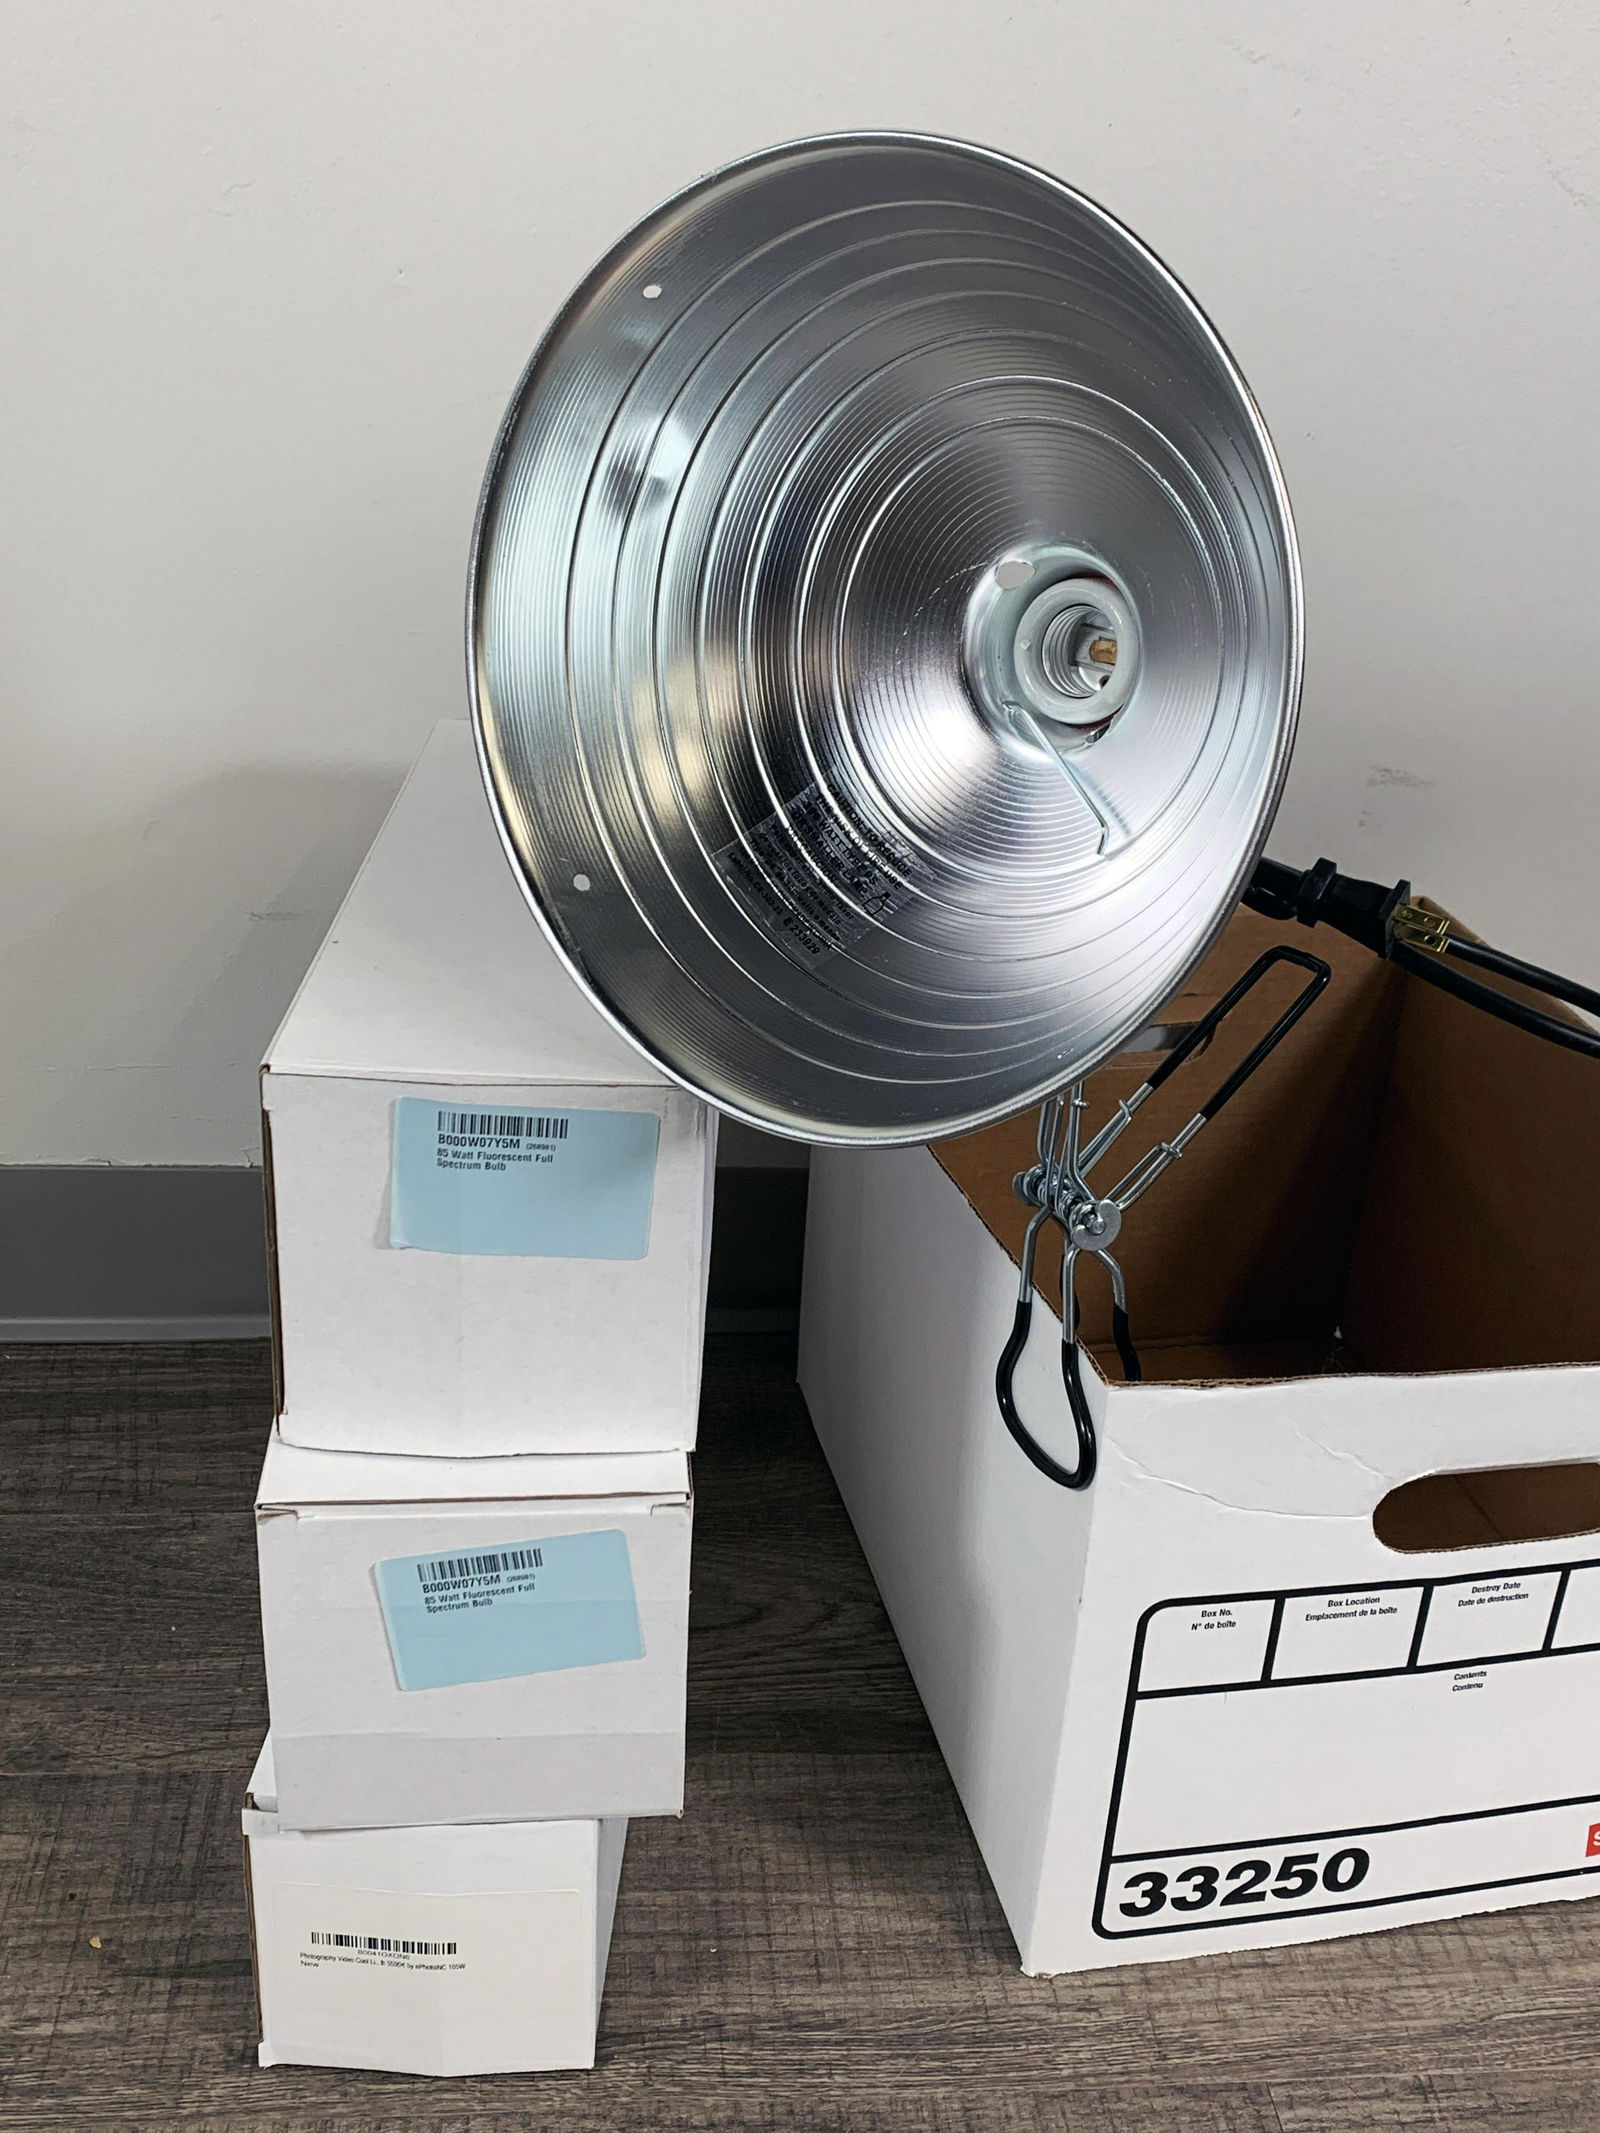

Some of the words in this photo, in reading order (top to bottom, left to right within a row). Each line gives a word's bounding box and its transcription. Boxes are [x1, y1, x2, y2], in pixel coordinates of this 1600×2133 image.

[438, 1134, 520, 1148] B000W07Y5M
[437, 1148, 448, 1157] 85
[451, 1150, 473, 1159] Watt
[477, 1151, 532, 1162] Fluorescent
[536, 1154, 553, 1163] Full
[437, 1158, 481, 1169] Spectrum
[485, 1162, 506, 1171] Bulb
[423, 1575, 501, 1594] B000W07Y5M
[1471, 1584, 1501, 1594] Destroy
[1503, 1582, 1522, 1590] Date
[424, 1596, 436, 1605] 85
[438, 1594, 460, 1602] Watt
[463, 1586, 515, 1600] Fluorescent
[518, 1583, 535, 1592] Full
[1458, 1599, 1475, 1608] Date
[1487, 1592, 1529, 1603] destruction
[426, 1602, 469, 1614] Spectrum
[472, 1599, 493, 1607] Bulb
[1327, 1599, 1343, 1608] Box
[1344, 1596, 1380, 1606] Location
[1201, 1609, 1217, 1618] Box
[1218, 1608, 1232, 1617] No.
[1305, 1610, 1358, 1621] Emplacement
[1358, 1608, 1368, 1617] de
[1370, 1608, 1377, 1616] la
[1204, 1621, 1215, 1630] de
[1454, 1670, 1488, 1680] Contents
[1452, 1682, 1484, 1692] Contenu
[1118, 1848, 1370, 1918] 33250
[300, 1952, 336, 1962] Photography
[300, 1960, 320, 1968] New
